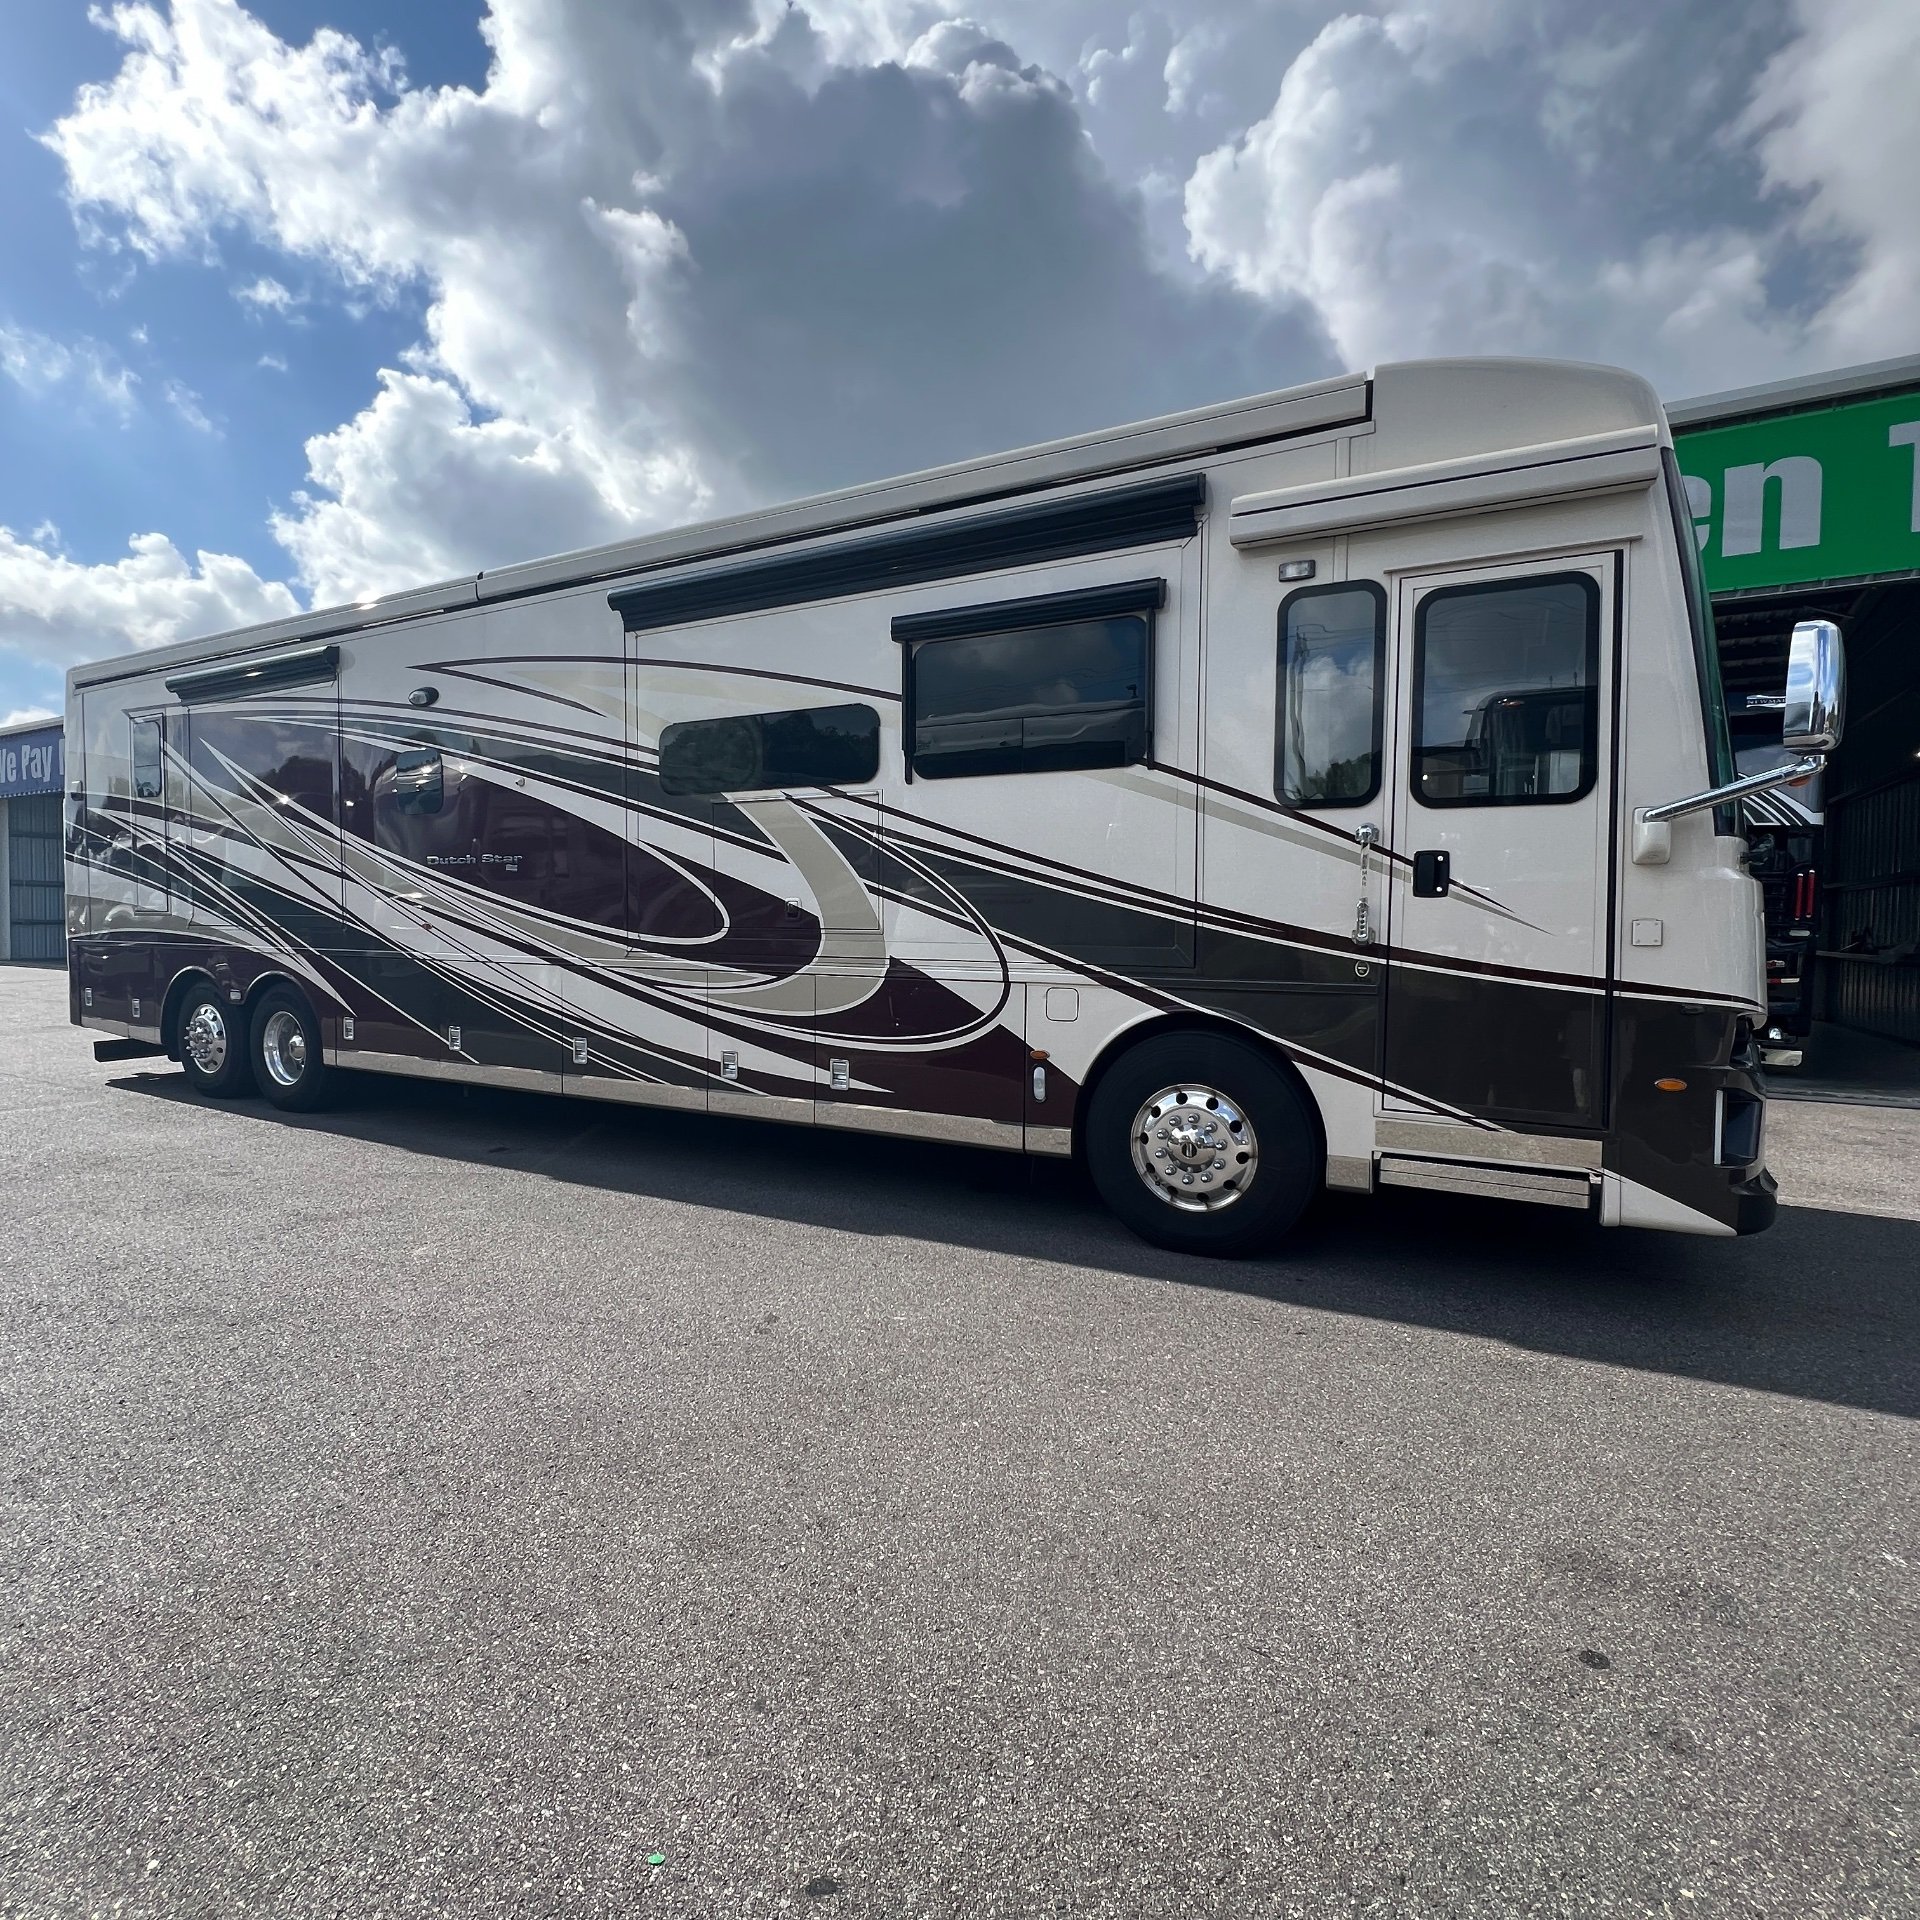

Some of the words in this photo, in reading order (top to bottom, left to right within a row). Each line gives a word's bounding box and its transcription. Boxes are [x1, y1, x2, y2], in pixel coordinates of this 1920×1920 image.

[21, 744, 53, 783] Pay
[426, 854, 477, 865] Dutch
[481, 853, 523, 864] Star
